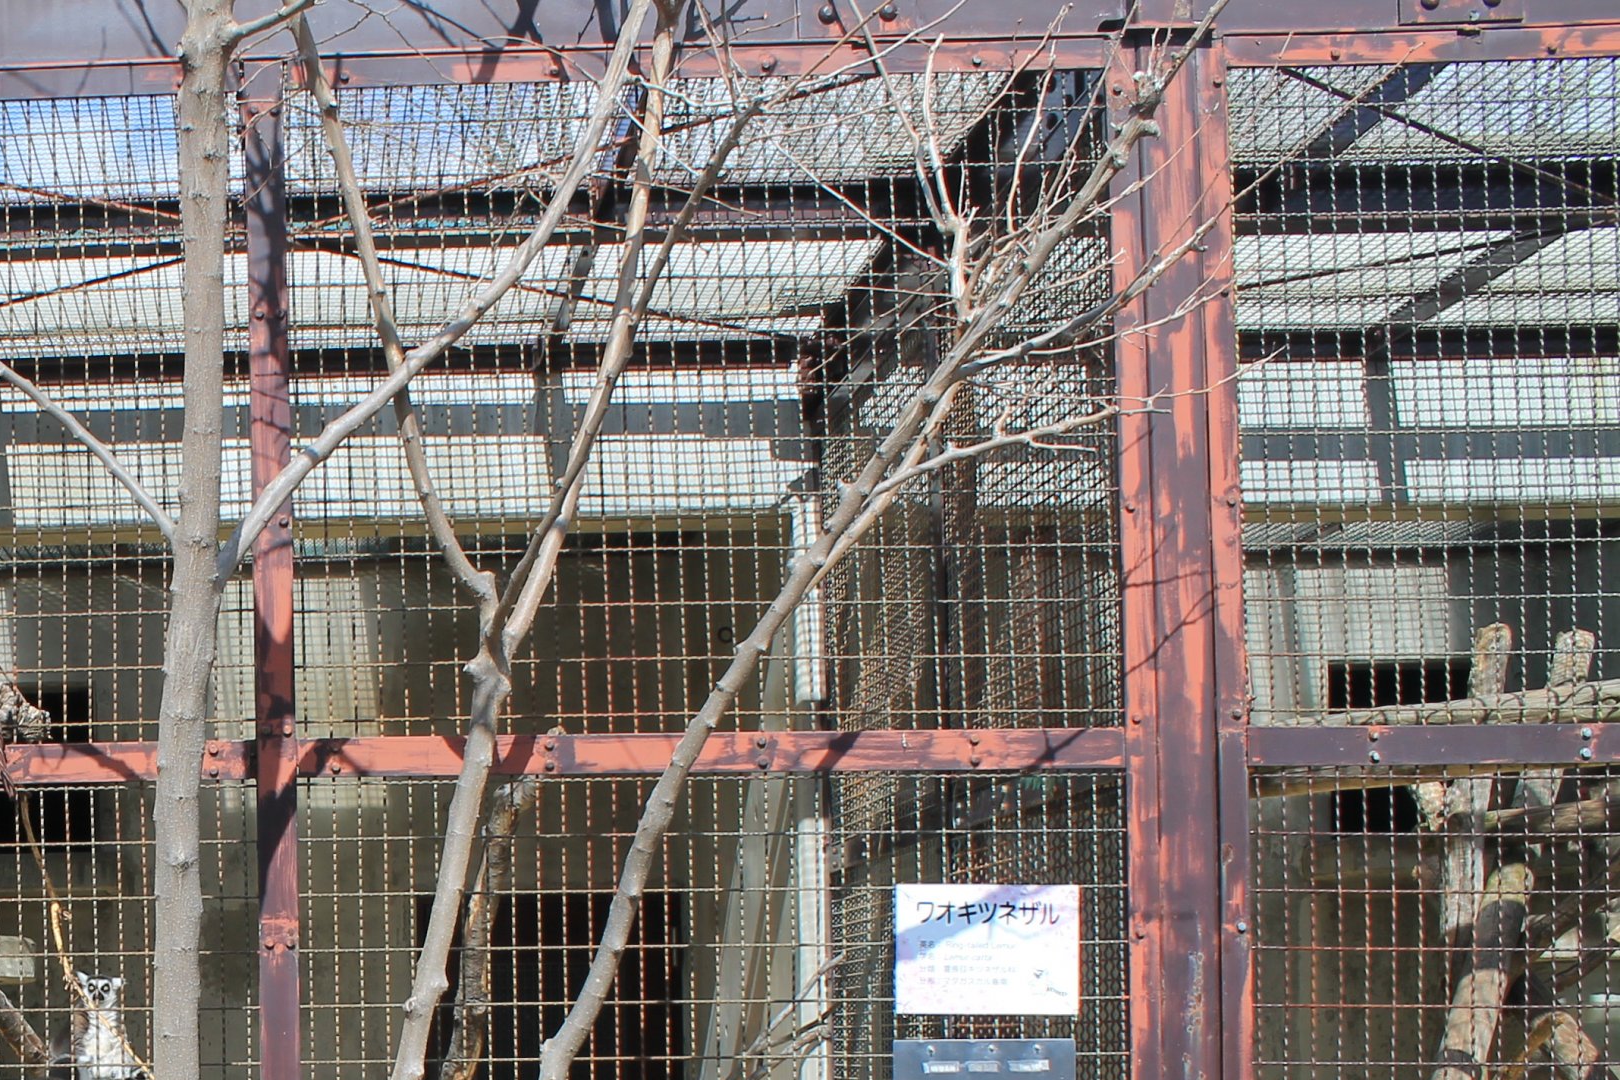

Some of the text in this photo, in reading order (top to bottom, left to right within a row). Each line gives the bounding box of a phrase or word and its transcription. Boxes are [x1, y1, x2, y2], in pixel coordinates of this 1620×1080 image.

[916, 900, 1061, 926] ワオキツネザル
